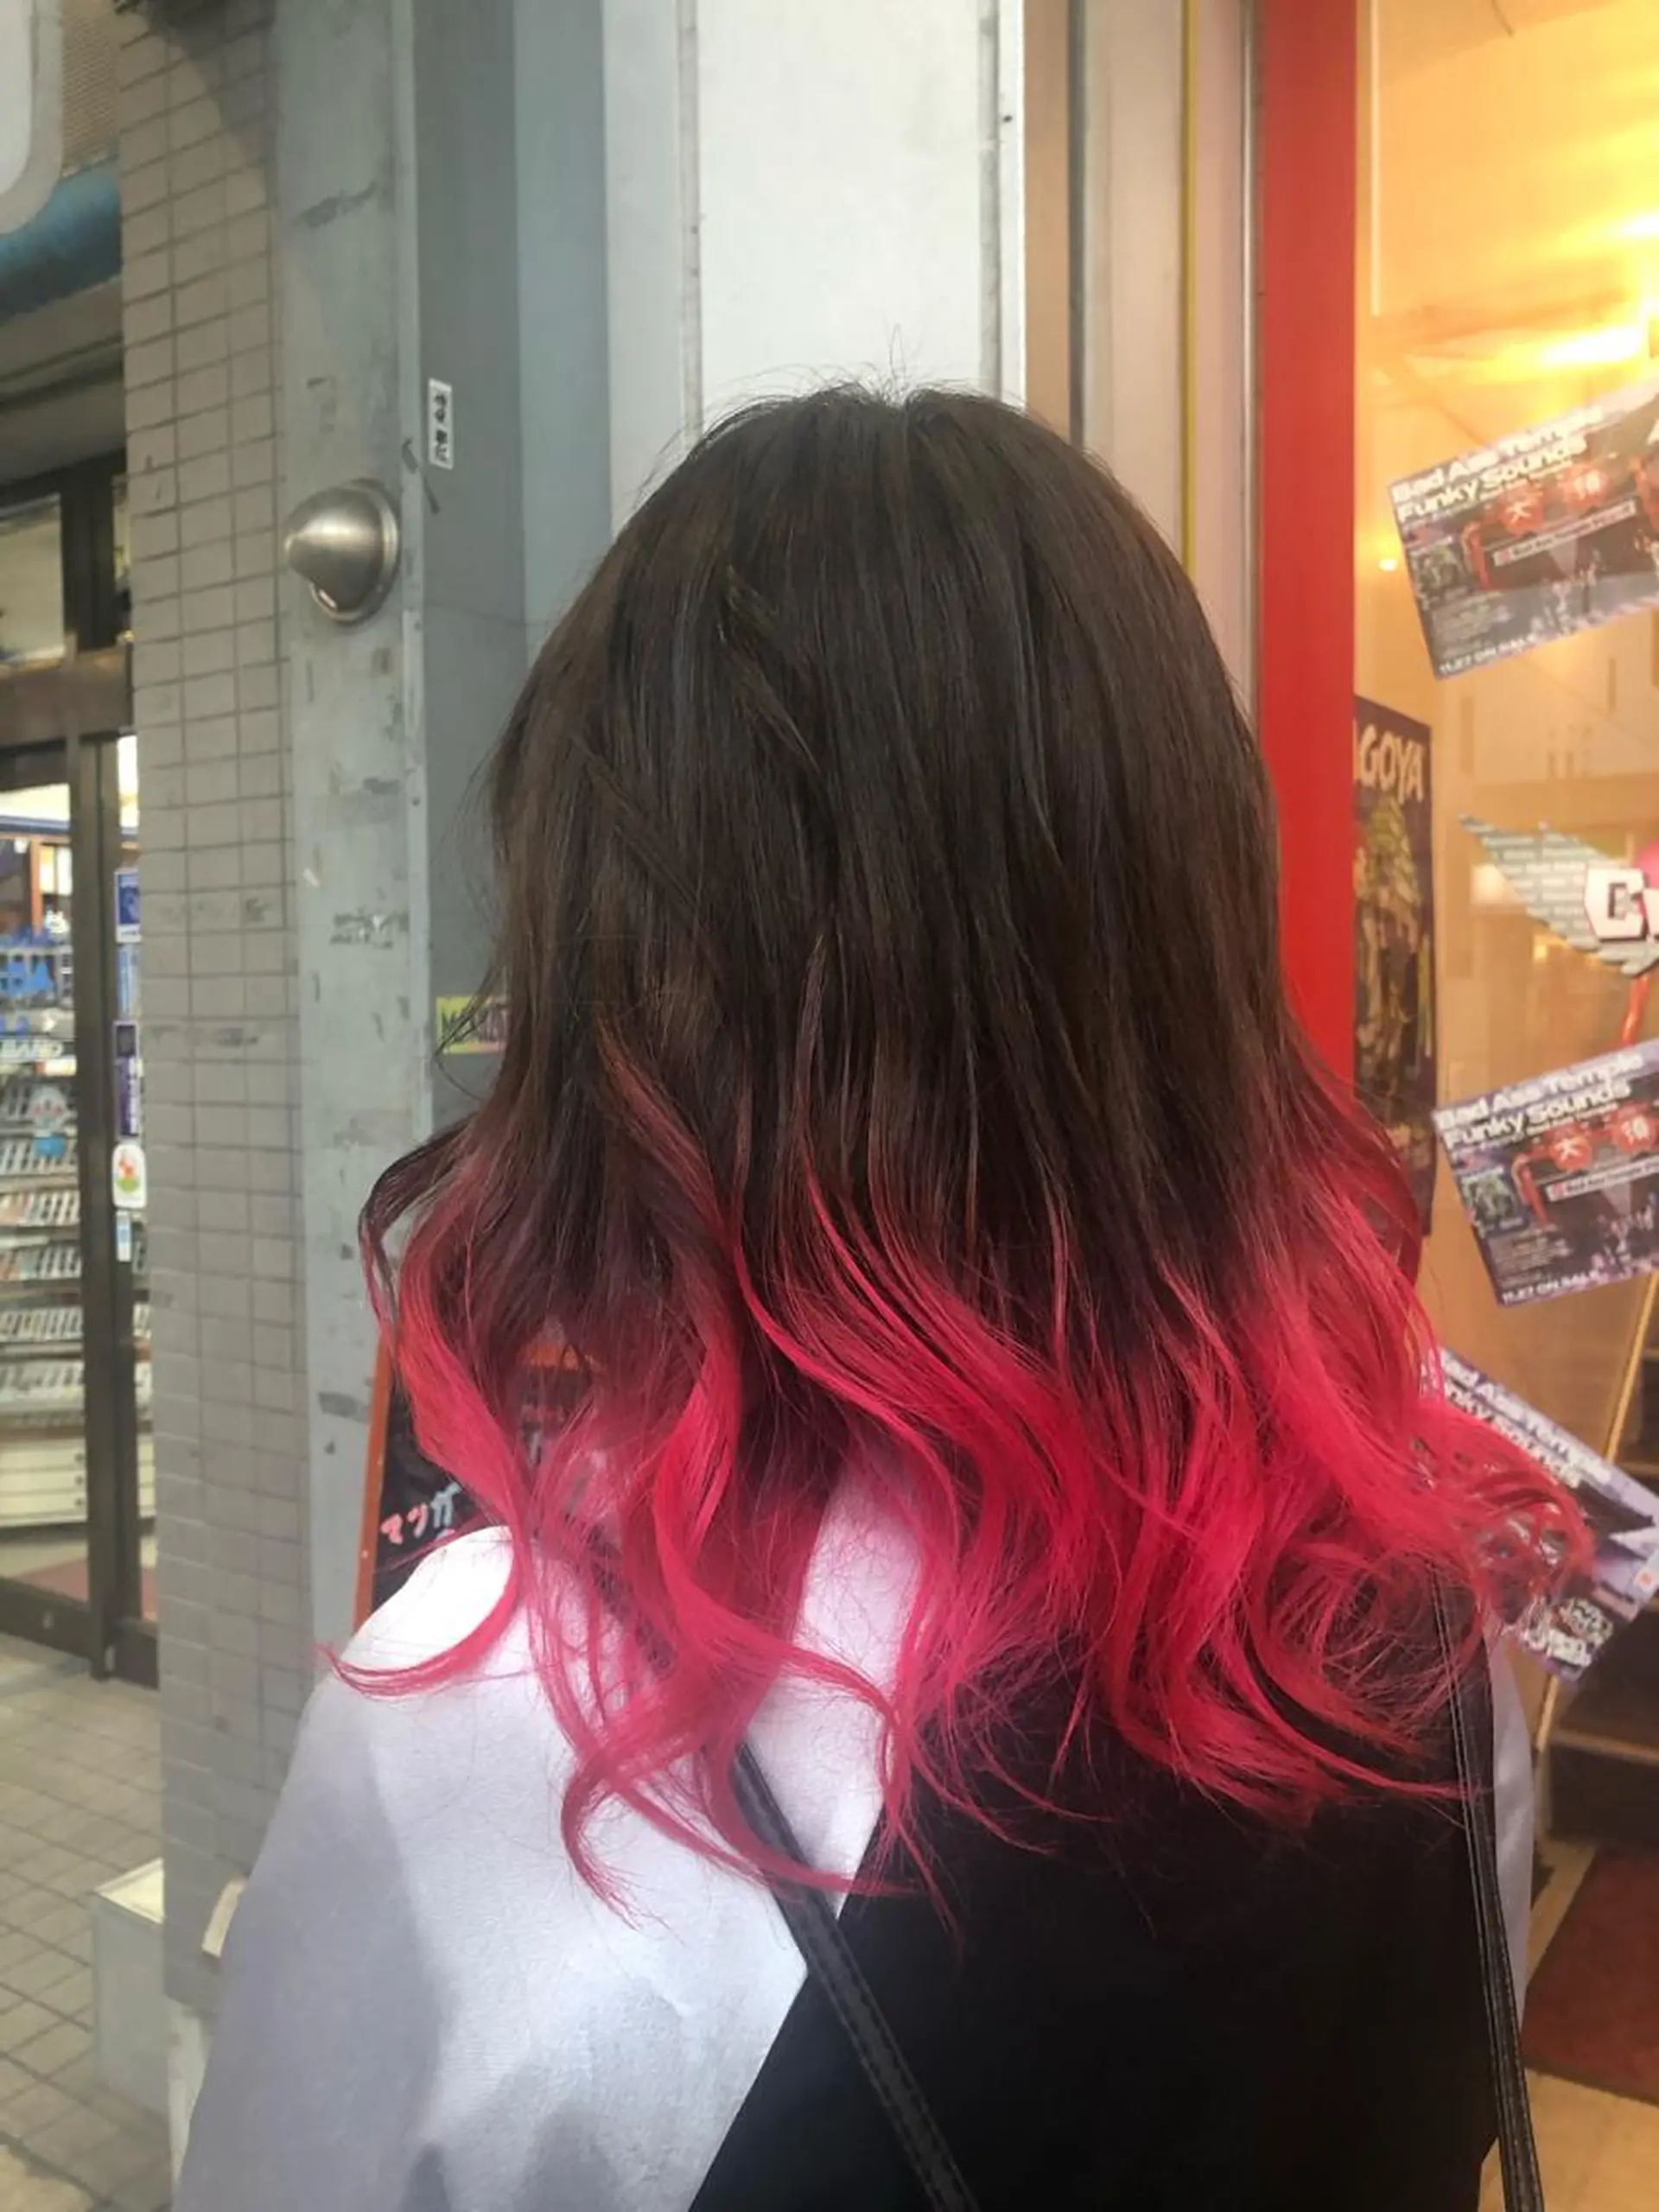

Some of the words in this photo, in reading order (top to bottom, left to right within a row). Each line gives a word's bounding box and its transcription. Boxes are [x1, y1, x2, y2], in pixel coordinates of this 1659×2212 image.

[1397, 476, 1481, 524] Funky
[1352, 717, 1423, 804] GOYA
[1443, 1110, 1526, 1149] Funky
